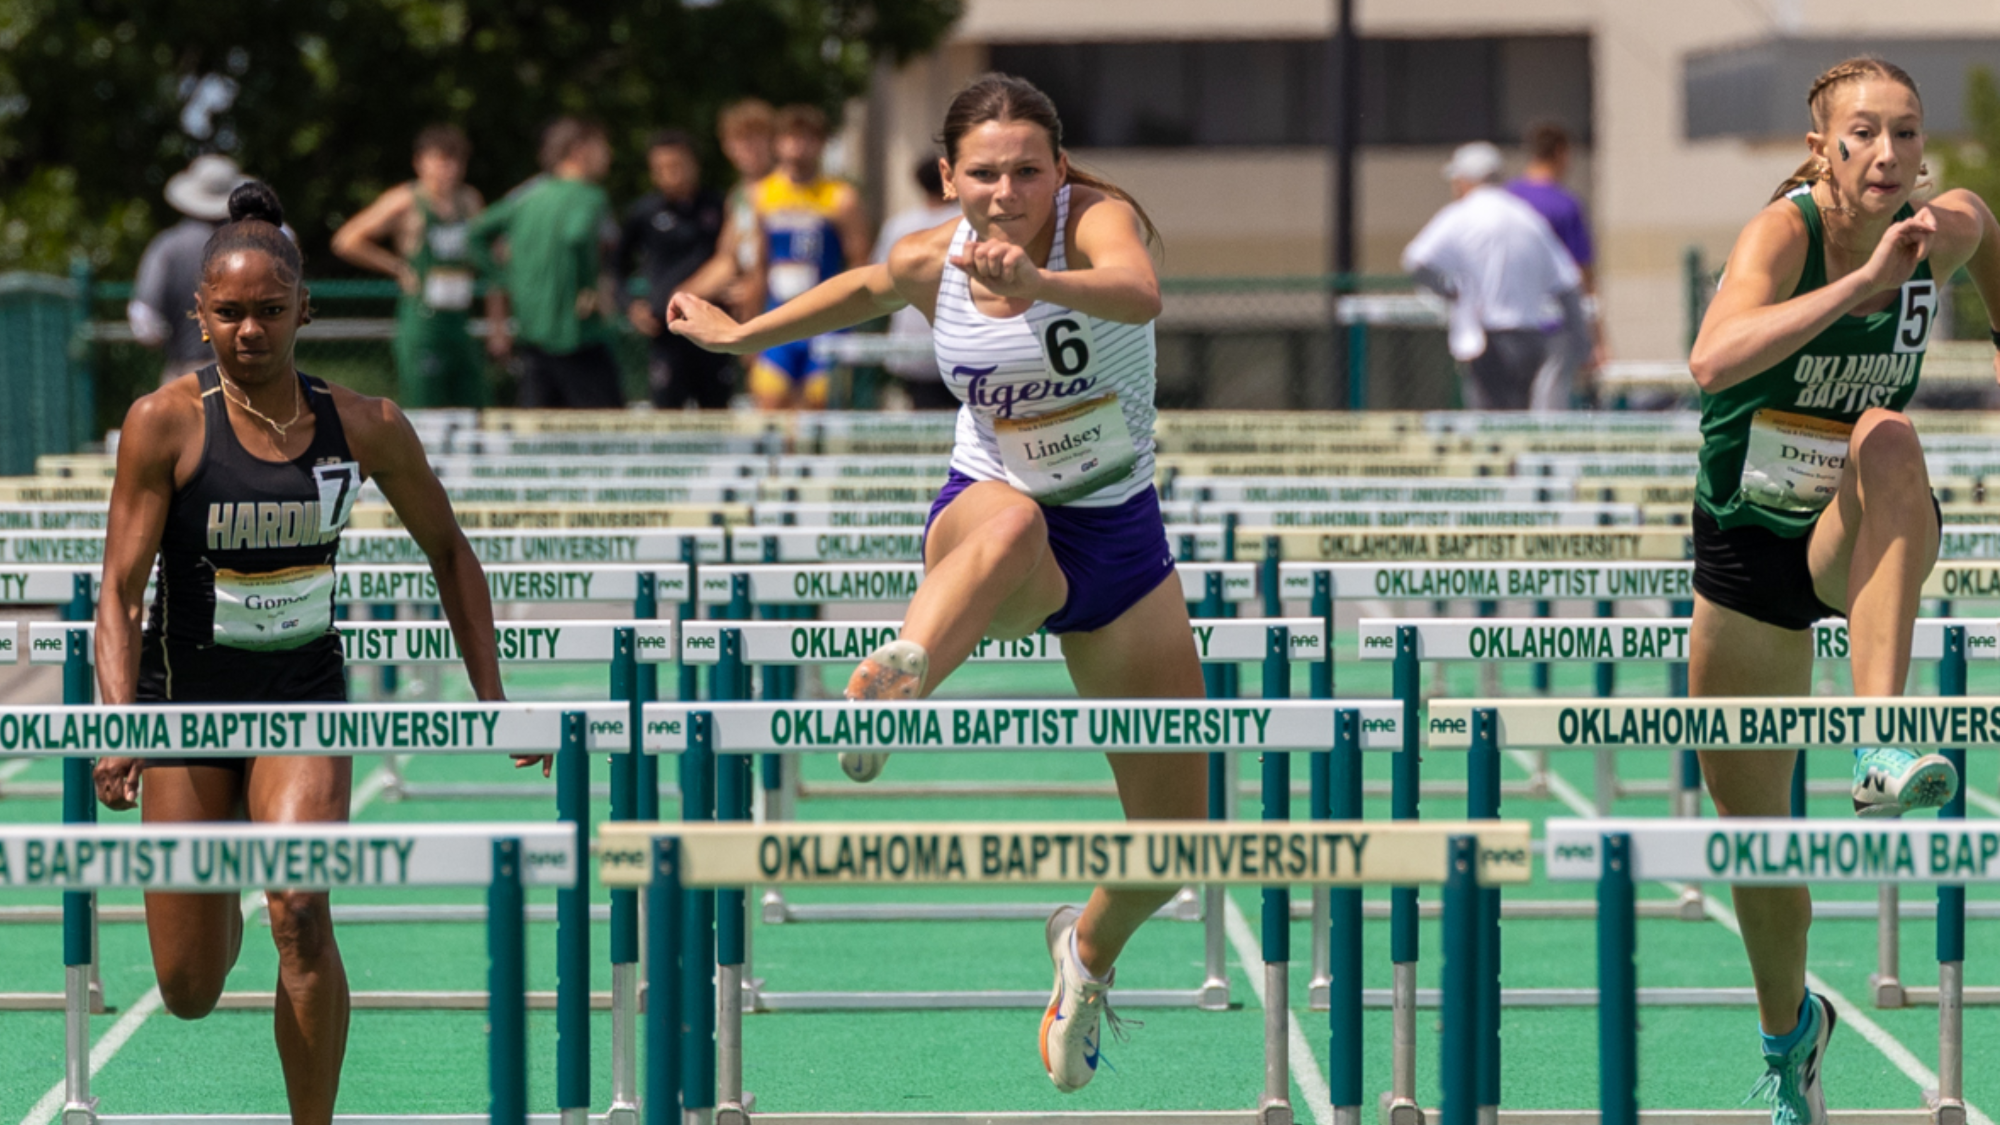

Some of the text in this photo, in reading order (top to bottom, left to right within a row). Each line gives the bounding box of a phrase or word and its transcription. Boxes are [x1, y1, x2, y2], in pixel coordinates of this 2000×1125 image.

[1902, 285, 1931, 347] 5
[1045, 319, 1089, 376] 6
[1794, 353, 1918, 387] OKLAHOMA
[951, 365, 1097, 418] Tigers
[1793, 381, 1900, 413] BAPTIST
[1023, 424, 1102, 461] Lindsey
[320, 467, 352, 527] 7
[14, 537, 104, 560] UNIVERS
[521, 536, 638, 558] UNIVERSITY
[1319, 534, 1641, 557] OKLAHOMA BAPTIST UNIVERSITY
[360, 572, 438, 598] BAPTIS
[794, 571, 918, 597] OKLAHOMA
[1375, 570, 1500, 595] OKLAHOMA
[1508, 569, 1600, 595] BAPTIST
[1608, 569, 1692, 595] UNIVER
[791, 627, 902, 658] OKLAHO
[1469, 627, 1614, 658] OKLAHOMA
[1622, 627, 1688, 658] BAPT
[1, 712, 171, 750] OKLAHOMA
[181, 711, 306, 749] BAPTIST
[317, 710, 500, 748] UNIVERSITY
[770, 710, 943, 747] OKLAHOMA
[953, 709, 1078, 746] BAPTIST
[1089, 708, 1271, 745] UNIVERSITY
[1558, 708, 1729, 745] OKLAHOMA
[1739, 707, 1866, 744] BAPTIST
[26, 838, 179, 886] BAPTIST
[192, 837, 416, 884] UNIVERSITY
[758, 835, 967, 878] OKLAHOMA
[981, 834, 1133, 878] BAPTIST
[1147, 833, 1369, 876] UNIVERSITY
[1706, 832, 1916, 875] OKLAHOMA
